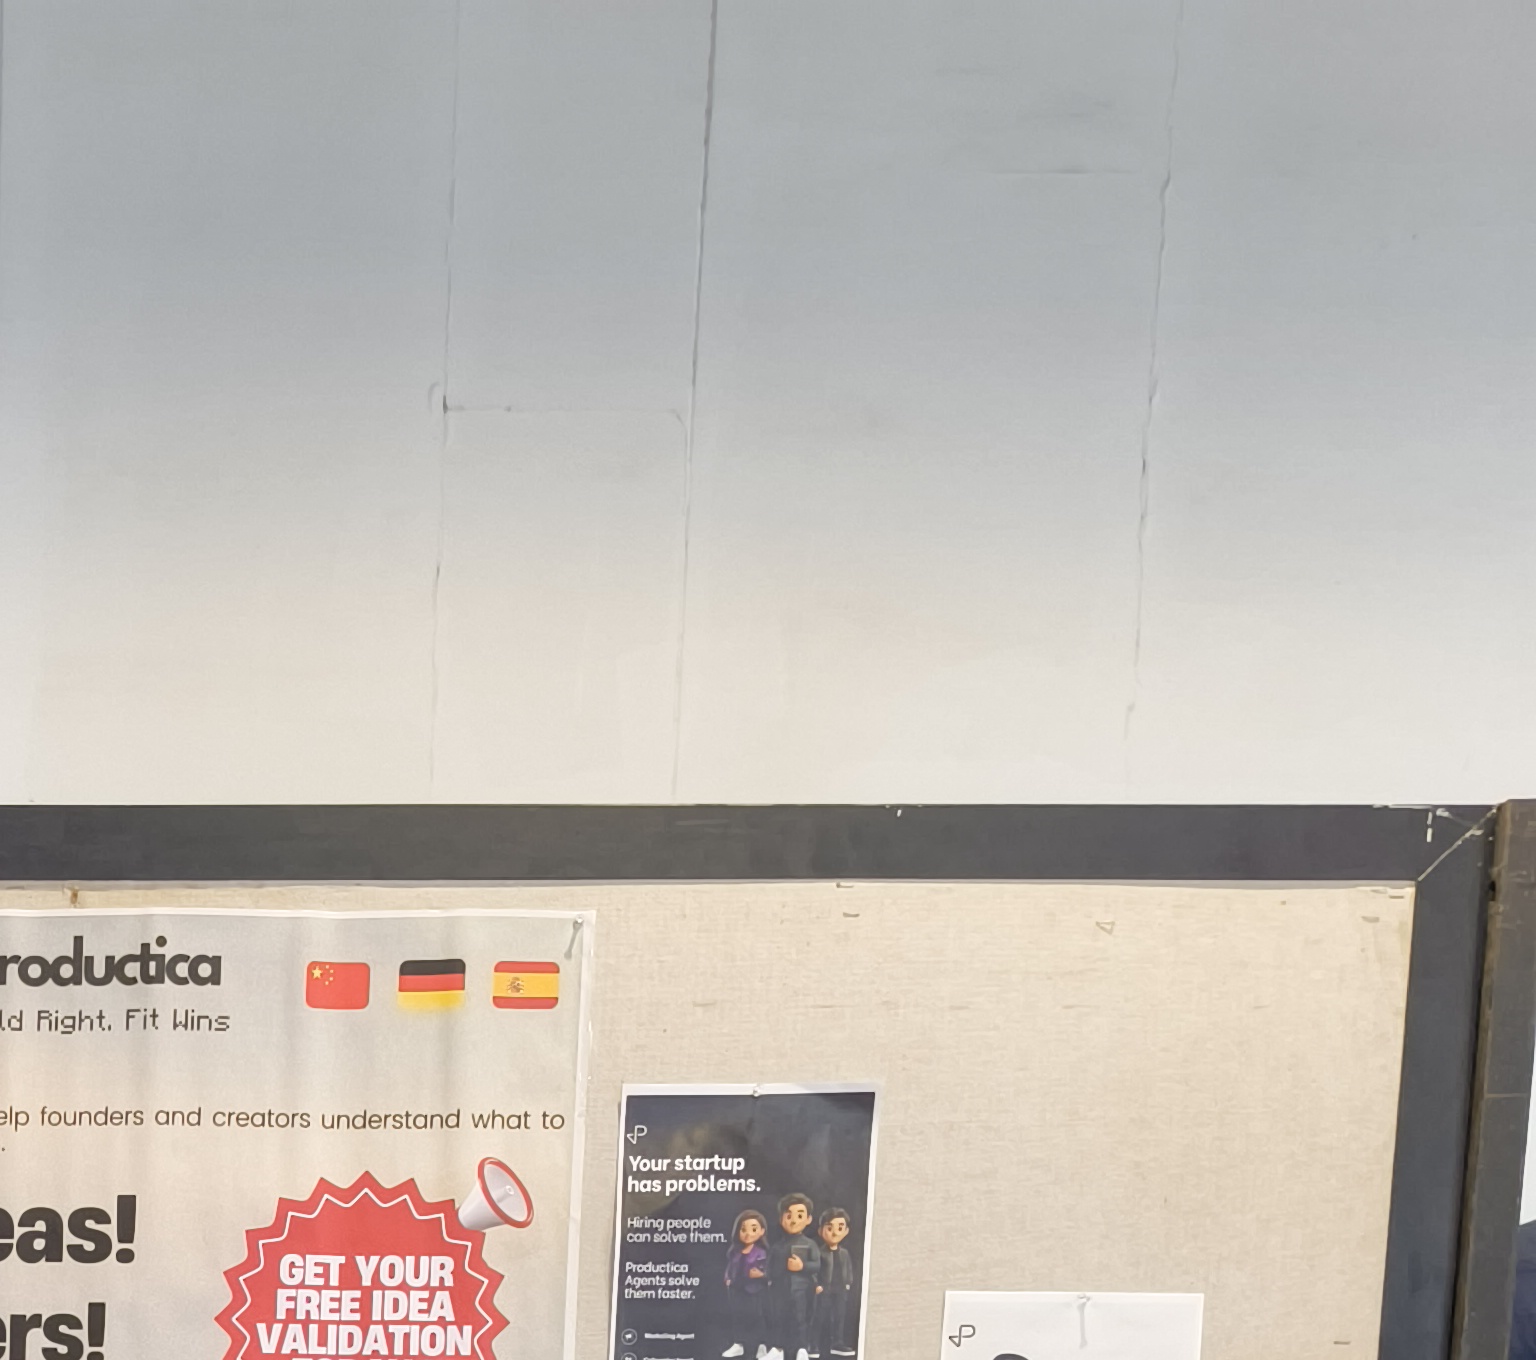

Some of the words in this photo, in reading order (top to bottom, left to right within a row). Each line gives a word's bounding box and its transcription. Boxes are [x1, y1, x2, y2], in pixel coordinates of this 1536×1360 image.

[125, 1009, 160, 1031] Fit
[172, 1010, 230, 1032] Wins
[40, 1107, 144, 1128] founders
[154, 1107, 202, 1128] and
[212, 1110, 311, 1129] creators
[321, 1109, 460, 1130] understand
[471, 1110, 531, 1130] what
[541, 1112, 565, 1130] to
[628, 1155, 671, 1172] Your
[674, 1154, 745, 1175] startup
[627, 1176, 662, 1193] has
[665, 1174, 762, 1196] problems.
[627, 1216, 664, 1231] Hiring
[667, 1216, 712, 1231] people
[626, 1232, 651, 1243] can
[653, 1232, 687, 1243] solve
[690, 1231, 728, 1243] them.
[279, 1253, 346, 1287] GET
[354, 1255, 455, 1288] YOUR
[625, 1261, 689, 1274] Productica
[625, 1275, 667, 1289] Agents
[668, 1275, 700, 1287] solve
[624, 1288, 656, 1300] them
[658, 1288, 696, 1300] faster.
[276, 1288, 362, 1321] FREE
[371, 1290, 456, 1322] IDEA
[256, 1322, 473, 1357] VALIDATION
